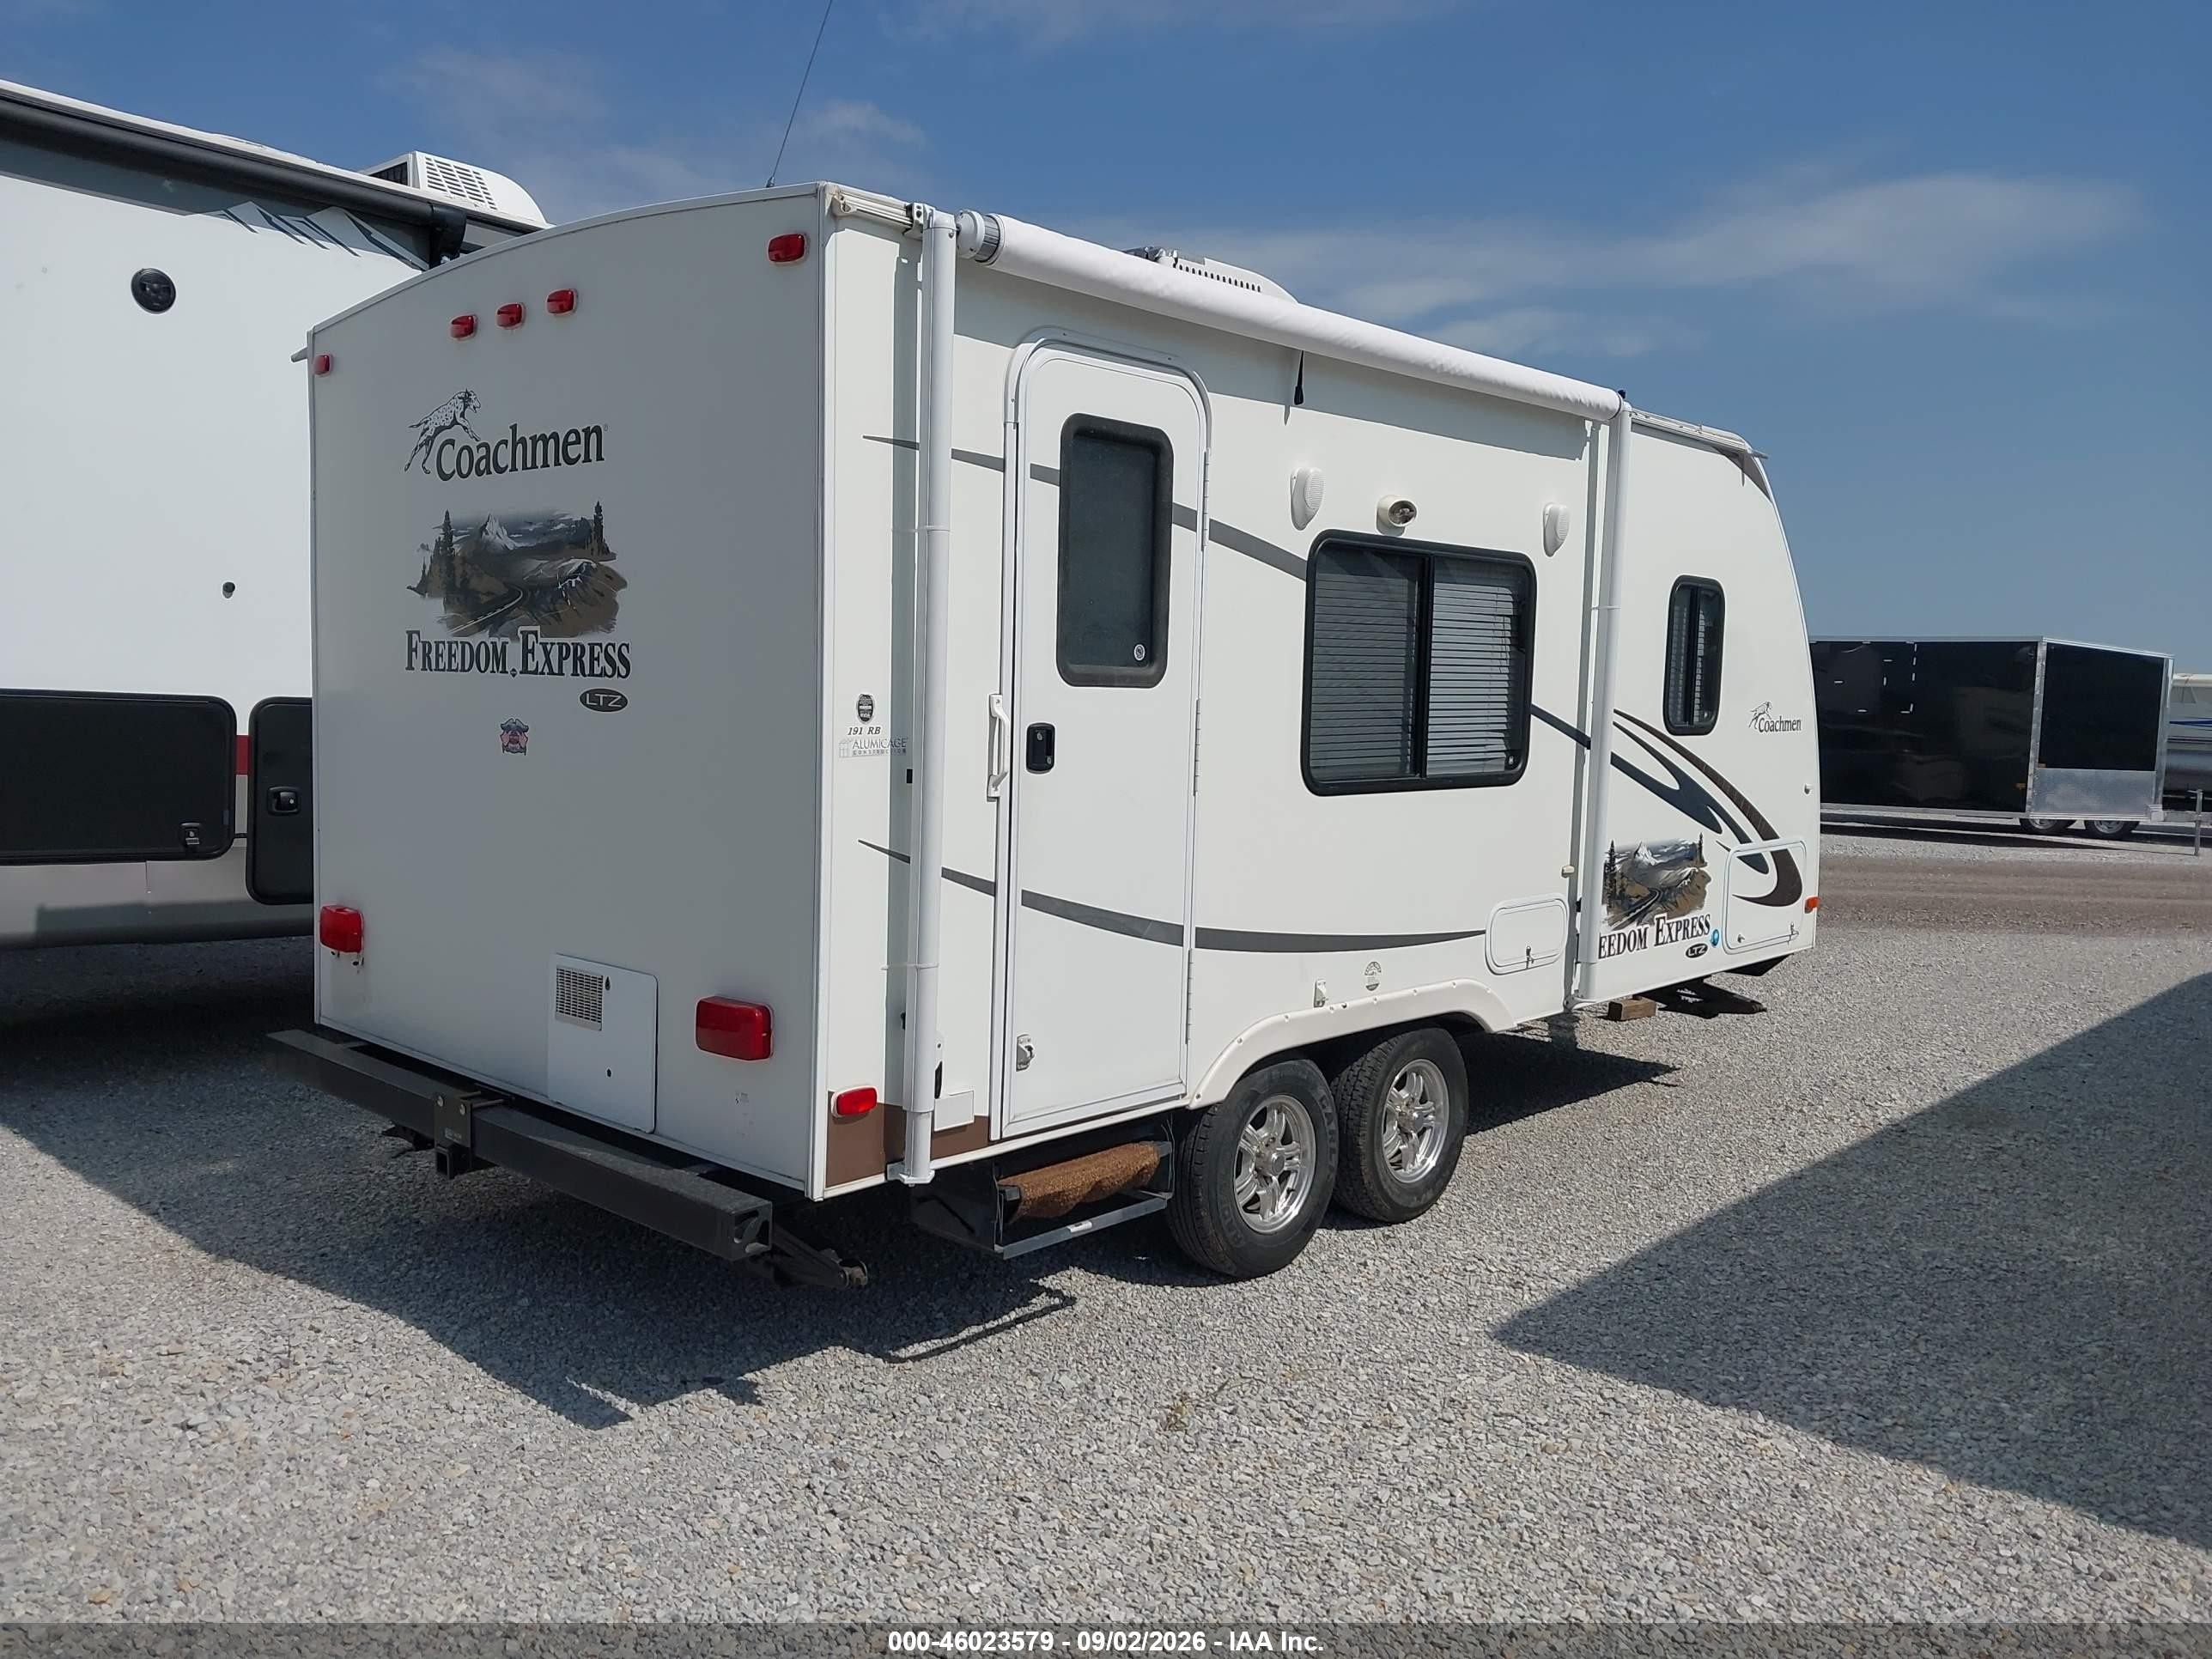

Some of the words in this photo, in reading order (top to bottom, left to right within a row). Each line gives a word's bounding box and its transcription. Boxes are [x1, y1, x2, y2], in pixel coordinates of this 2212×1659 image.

[435, 422, 605, 482] Coachmen
[585, 692, 623, 708] LTZ
[847, 726, 863, 736] 191
[867, 726, 882, 735] RB
[1758, 715, 1802, 733] Coachmen
[852, 738, 908, 750] ALUMICAGE
[1598, 927, 1650, 960] EEDOM
[1687, 945, 1706, 957] LTZ
